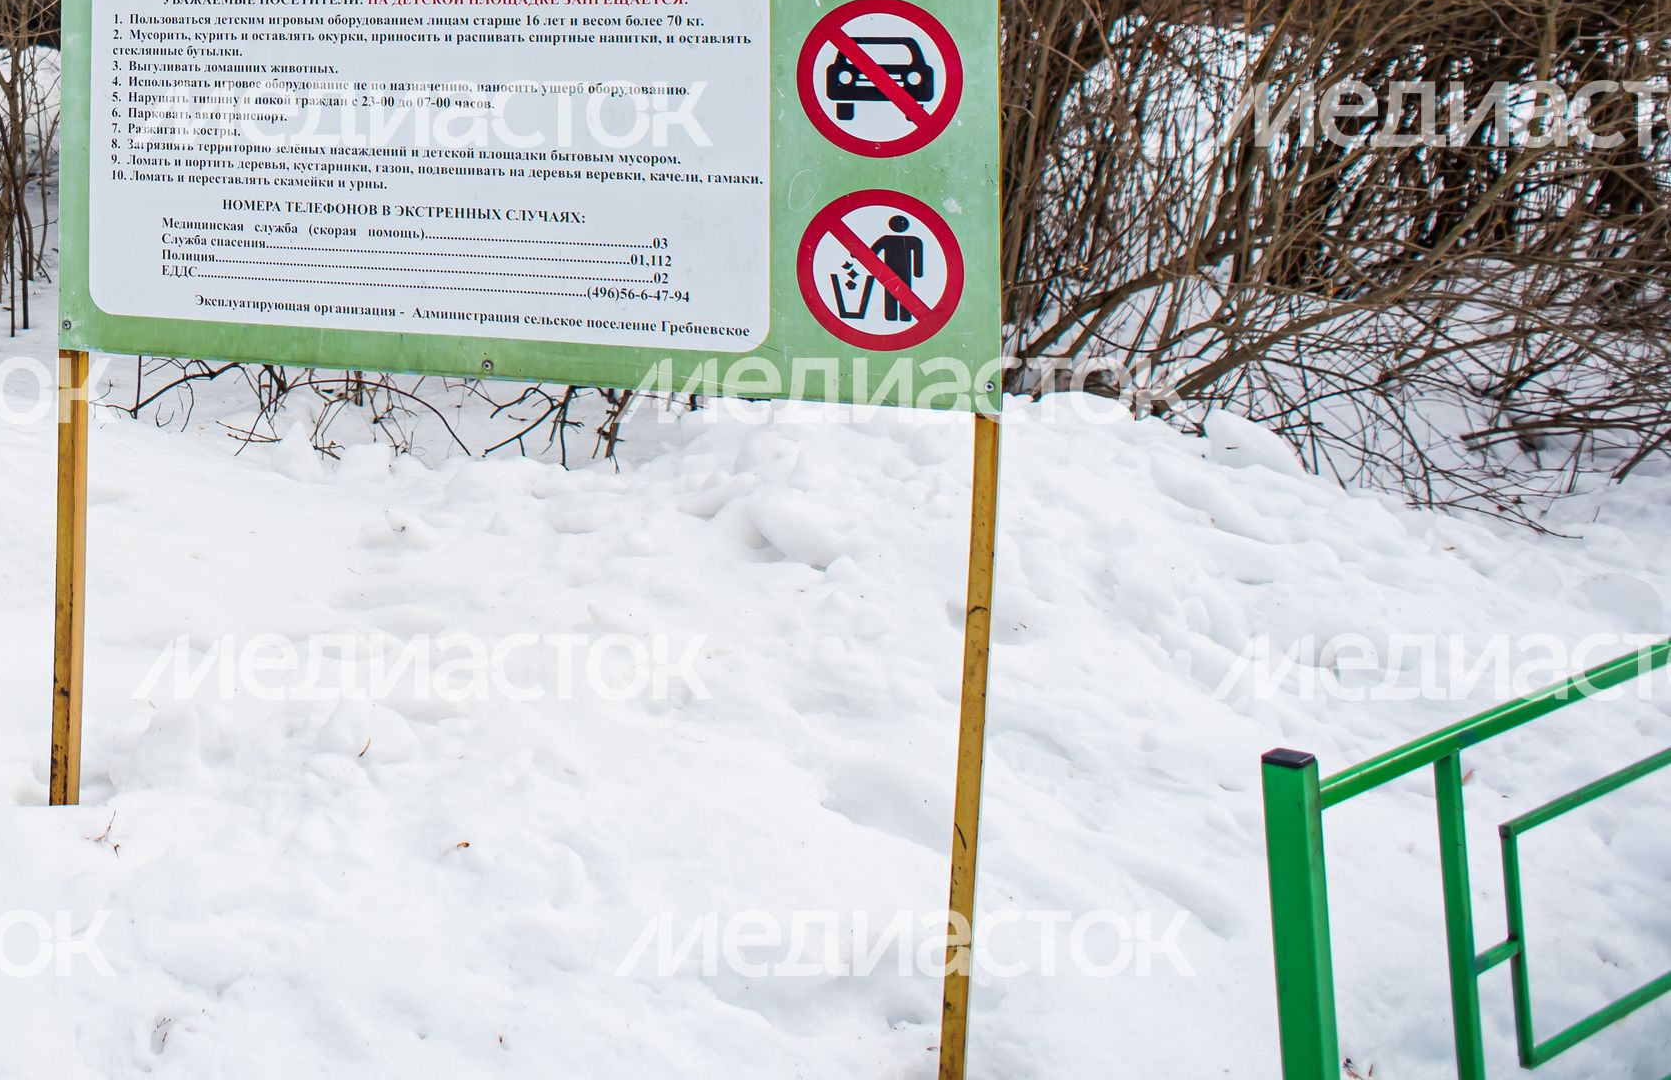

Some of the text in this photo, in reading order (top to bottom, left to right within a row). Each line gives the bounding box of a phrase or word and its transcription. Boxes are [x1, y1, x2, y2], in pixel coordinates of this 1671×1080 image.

[128, 12, 212, 25] Пользоваться
[212, 15, 265, 27] детским
[267, 15, 324, 29] игровым
[326, 13, 424, 29] оборудованием
[425, 16, 470, 27] лицам
[471, 16, 522, 30] старше
[525, 13, 541, 27] 16
[542, 16, 567, 27] лет
[581, 16, 622, 27] весом
[623, 13, 664, 27] более
[665, 13, 684, 27] 70
[193, 31, 238, 44] курить
[250, 31, 315, 42] оставлять
[370, 32, 441, 46] приносить
[455, 32, 526, 46] распивать
[527, 32, 596, 47] спиртные
[677, 33, 752, 45] оставлять
[111, 46, 184, 57] стеклянные
[127, 59, 202, 75] Выгуливать
[202, 63, 268, 74] домашних
[328, 144, 408, 158] насаждений
[421, 146, 475, 160] детской
[477, 149, 547, 162] площадки
[549, 148, 615, 164] бытовым
[125, 153, 171, 167] Ломать
[184, 158, 235, 171] портить
[416, 164, 506, 177] подвешивать
[527, 168, 582, 182] деревья
[128, 169, 175, 183] Ломать
[187, 173, 271, 187] переставлять
[272, 175, 334, 188] скамейки
[221, 197, 586, 224] НОМЕРА ТЕЛЕФОНОВ ЭКСТРЕННЫХ СЛУЧАЯХ:
[161, 216, 357, 239] Медицинская служба (скорая
[194, 293, 396, 318] Эксплуатирующая организация
[411, 306, 751, 338] Администрация сельское поселение Гребневское
